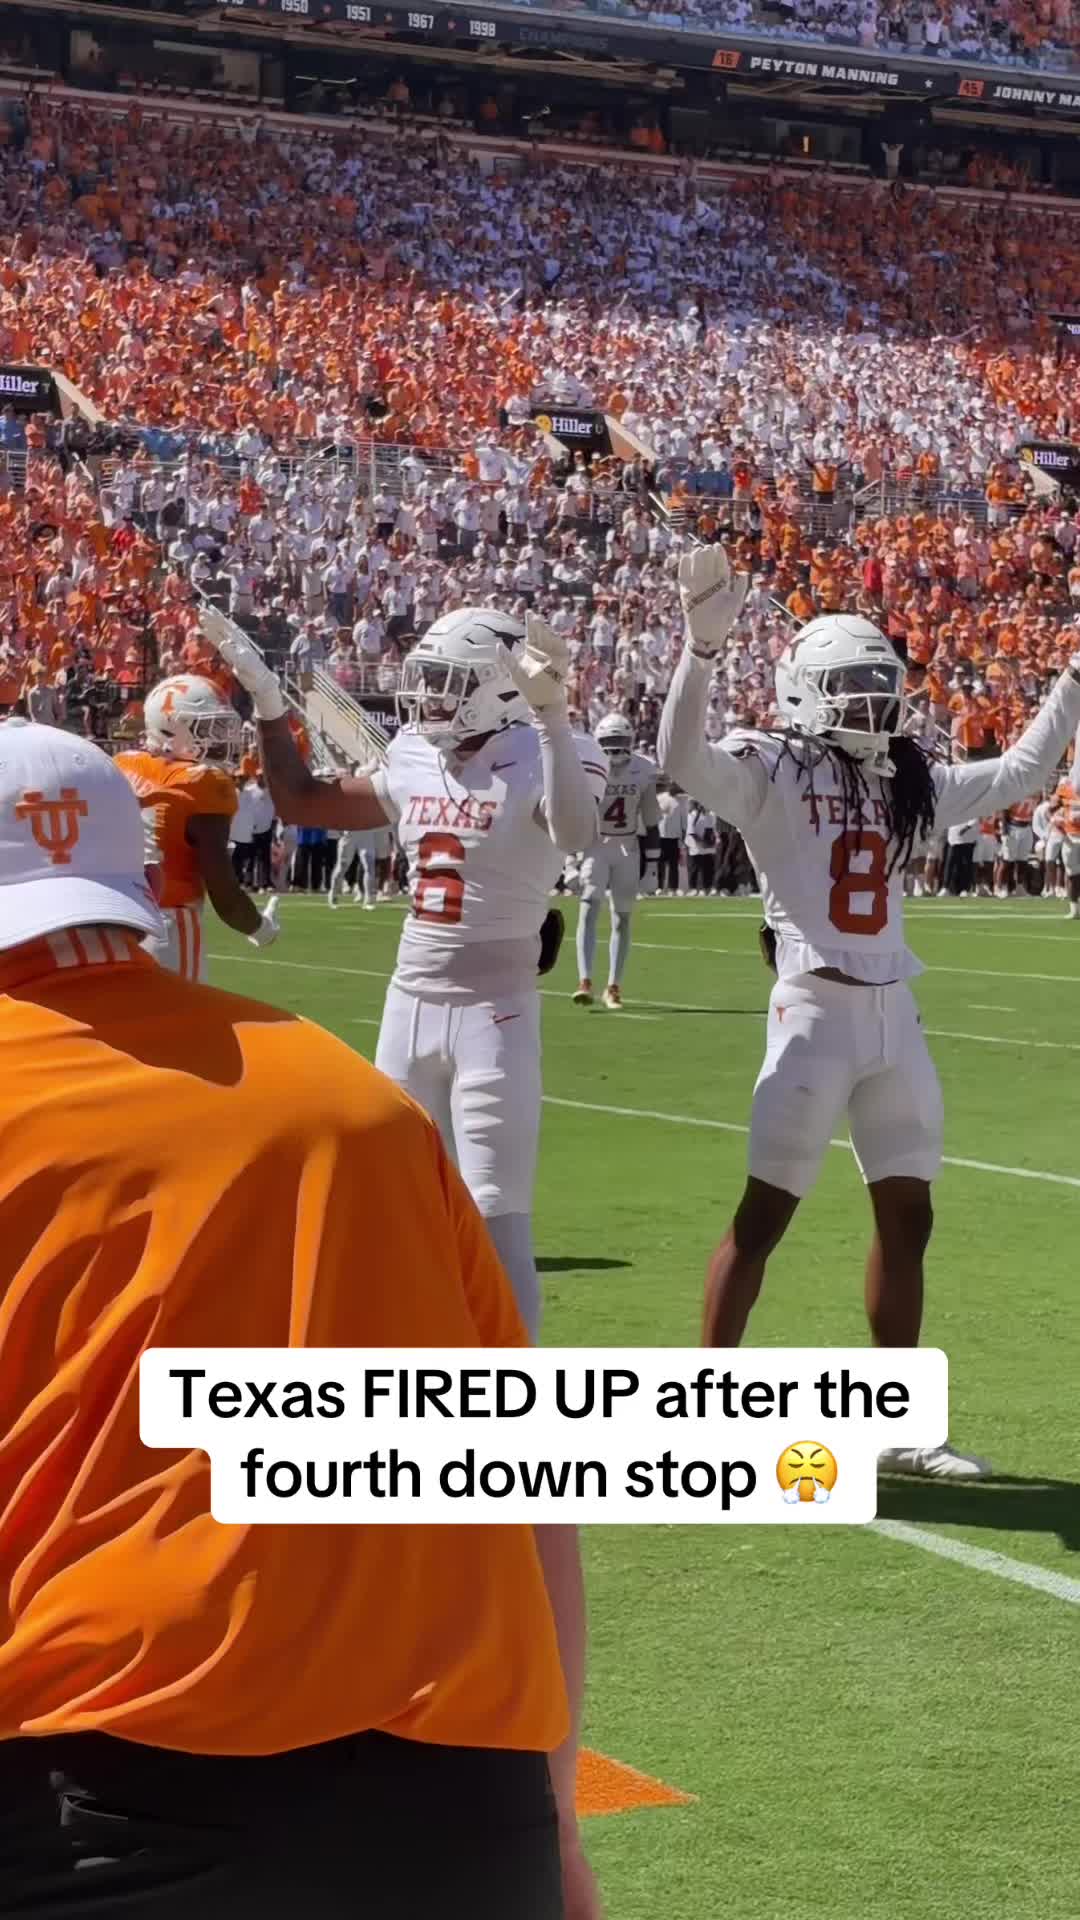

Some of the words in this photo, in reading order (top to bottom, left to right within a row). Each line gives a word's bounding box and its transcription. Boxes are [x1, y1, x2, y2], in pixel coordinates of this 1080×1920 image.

[281, 0, 308, 13] 1950
[346, 4, 370, 21] 1951
[408, 12, 434, 29] 1967
[469, 20, 496, 37] 1998
[719, 52, 735, 65] 16
[750, 56, 817, 75] PEYTON
[821, 65, 899, 85] MANNING
[993, 86, 1056, 104] JOHNNY
[551, 416, 592, 434] Hiller
[1034, 450, 1069, 466] Hiller
[605, 783, 636, 797] EXAS
[405, 795, 497, 831] TEXAS
[603, 797, 627, 829] 4
[415, 831, 466, 925] 6
[829, 830, 888, 935] 8
